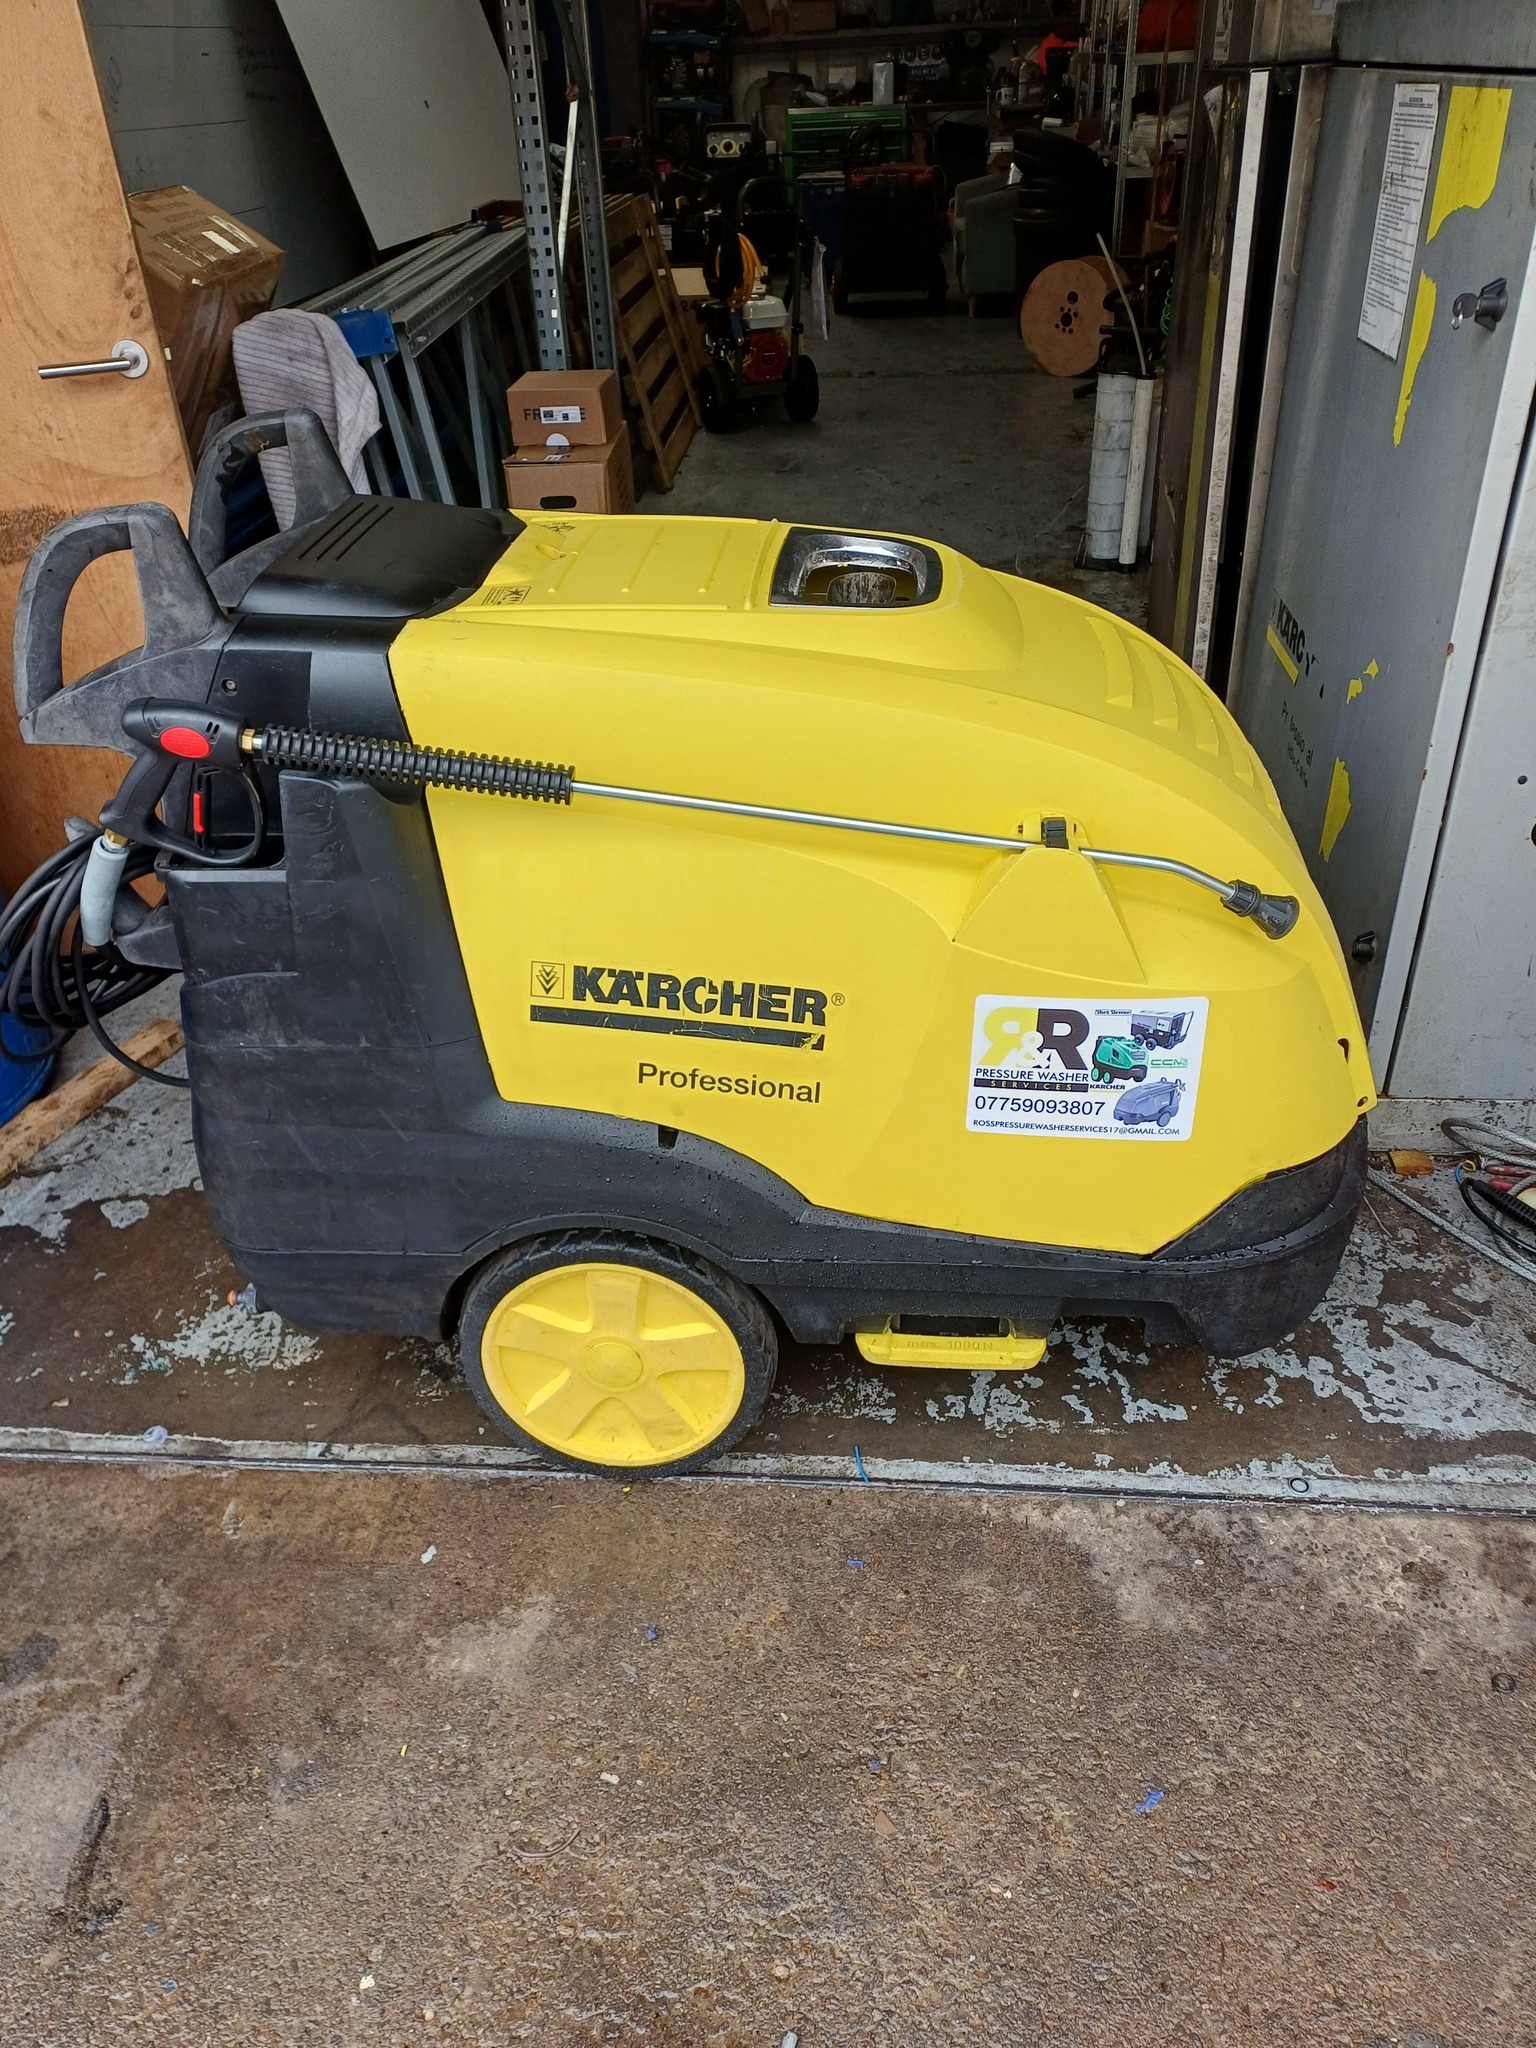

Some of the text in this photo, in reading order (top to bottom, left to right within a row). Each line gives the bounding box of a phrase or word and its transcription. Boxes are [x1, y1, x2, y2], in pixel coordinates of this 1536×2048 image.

[638, 1062, 821, 1104] Professional
[975, 1068, 1089, 1082] PRESSURE WASHER
[990, 1080, 1073, 1091] SERVICES
[975, 1095, 1106, 1116] 07759093807
[973, 1119, 1180, 1135] ROSSPRESSUREWASHERSERVICES17@GMAIL.COM
